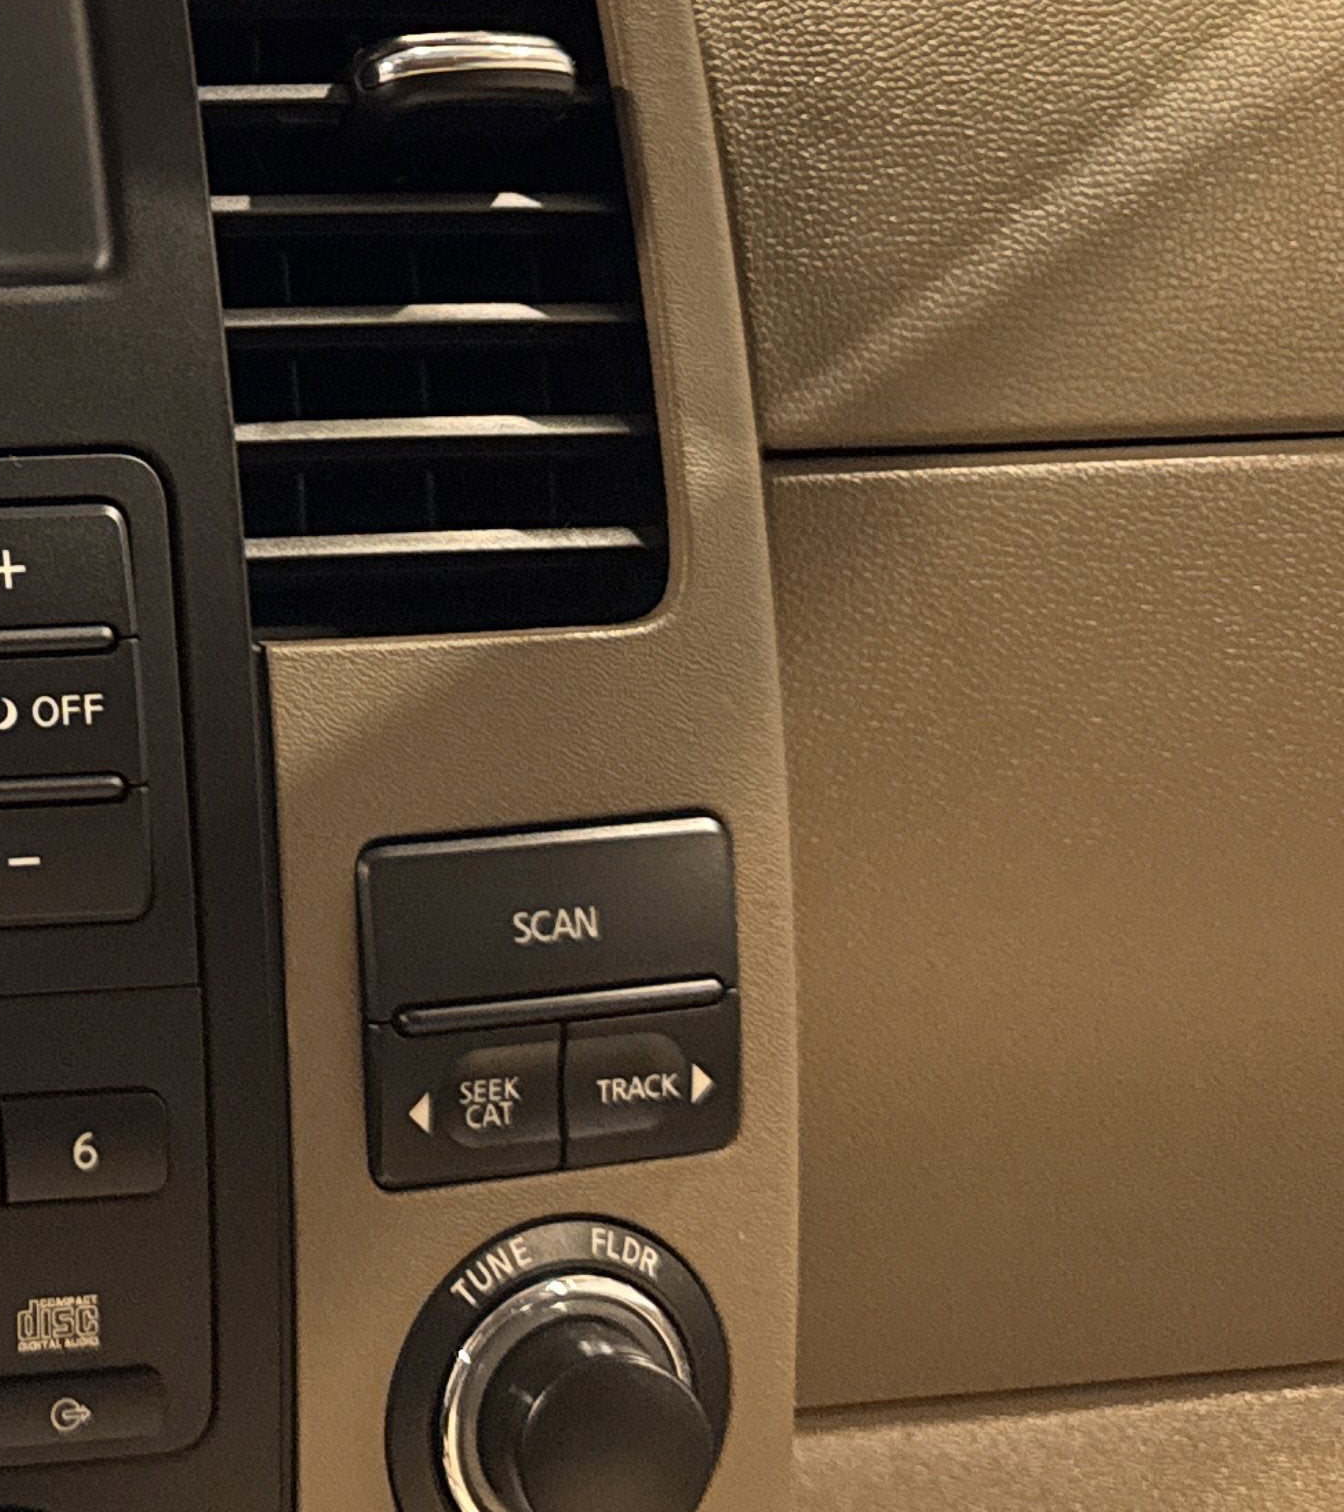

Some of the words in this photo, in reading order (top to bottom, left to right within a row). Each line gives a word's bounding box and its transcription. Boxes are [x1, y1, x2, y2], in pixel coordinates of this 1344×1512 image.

[32, 695, 105, 728] OFF
[512, 906, 600, 944] SCAN
[459, 1076, 519, 1104] SEEK
[596, 1072, 679, 1104] TRACK
[465, 1099, 514, 1129] CAT
[72, 1131, 99, 1171] 6
[590, 1226, 660, 1278] FLDR
[450, 1234, 534, 1306] TUNE
